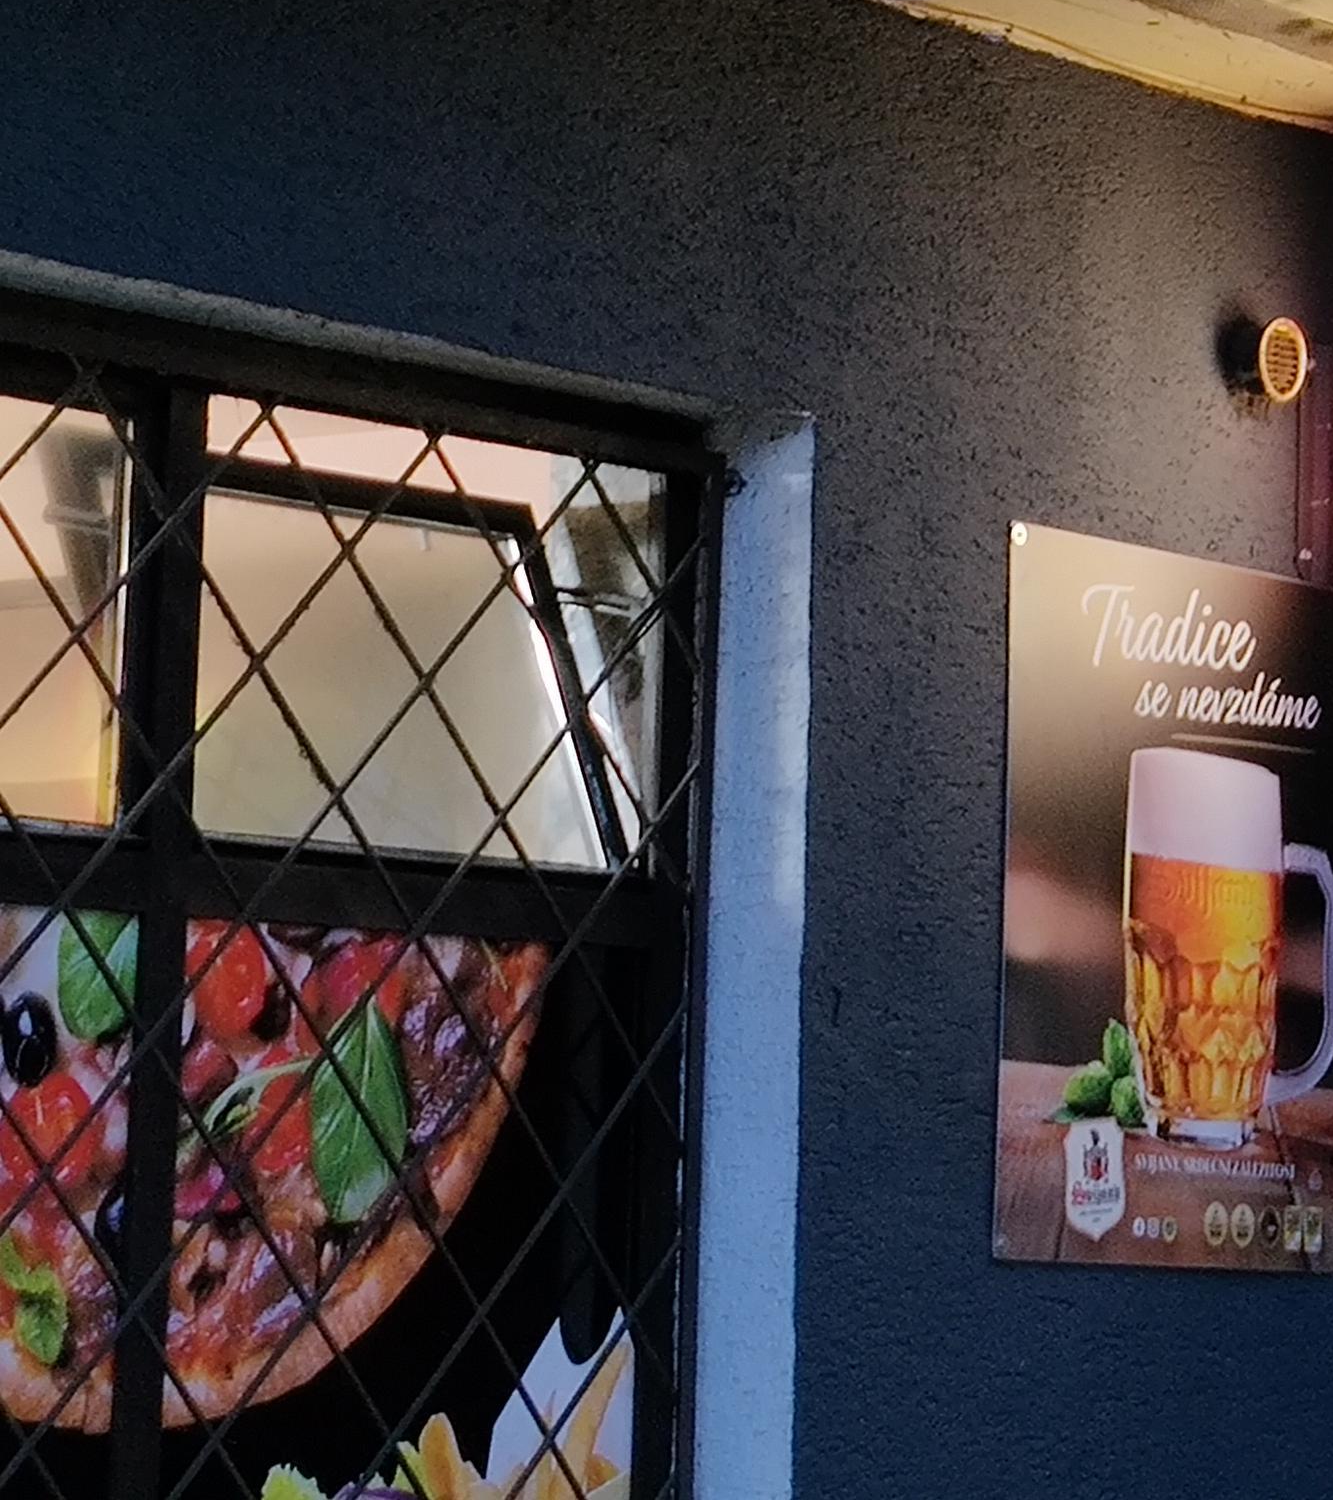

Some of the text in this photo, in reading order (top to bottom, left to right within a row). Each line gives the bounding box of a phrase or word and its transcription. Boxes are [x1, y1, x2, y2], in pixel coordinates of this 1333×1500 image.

[1081, 583, 1257, 672] Tradice
[1133, 671, 1322, 730] se nevzdáme
